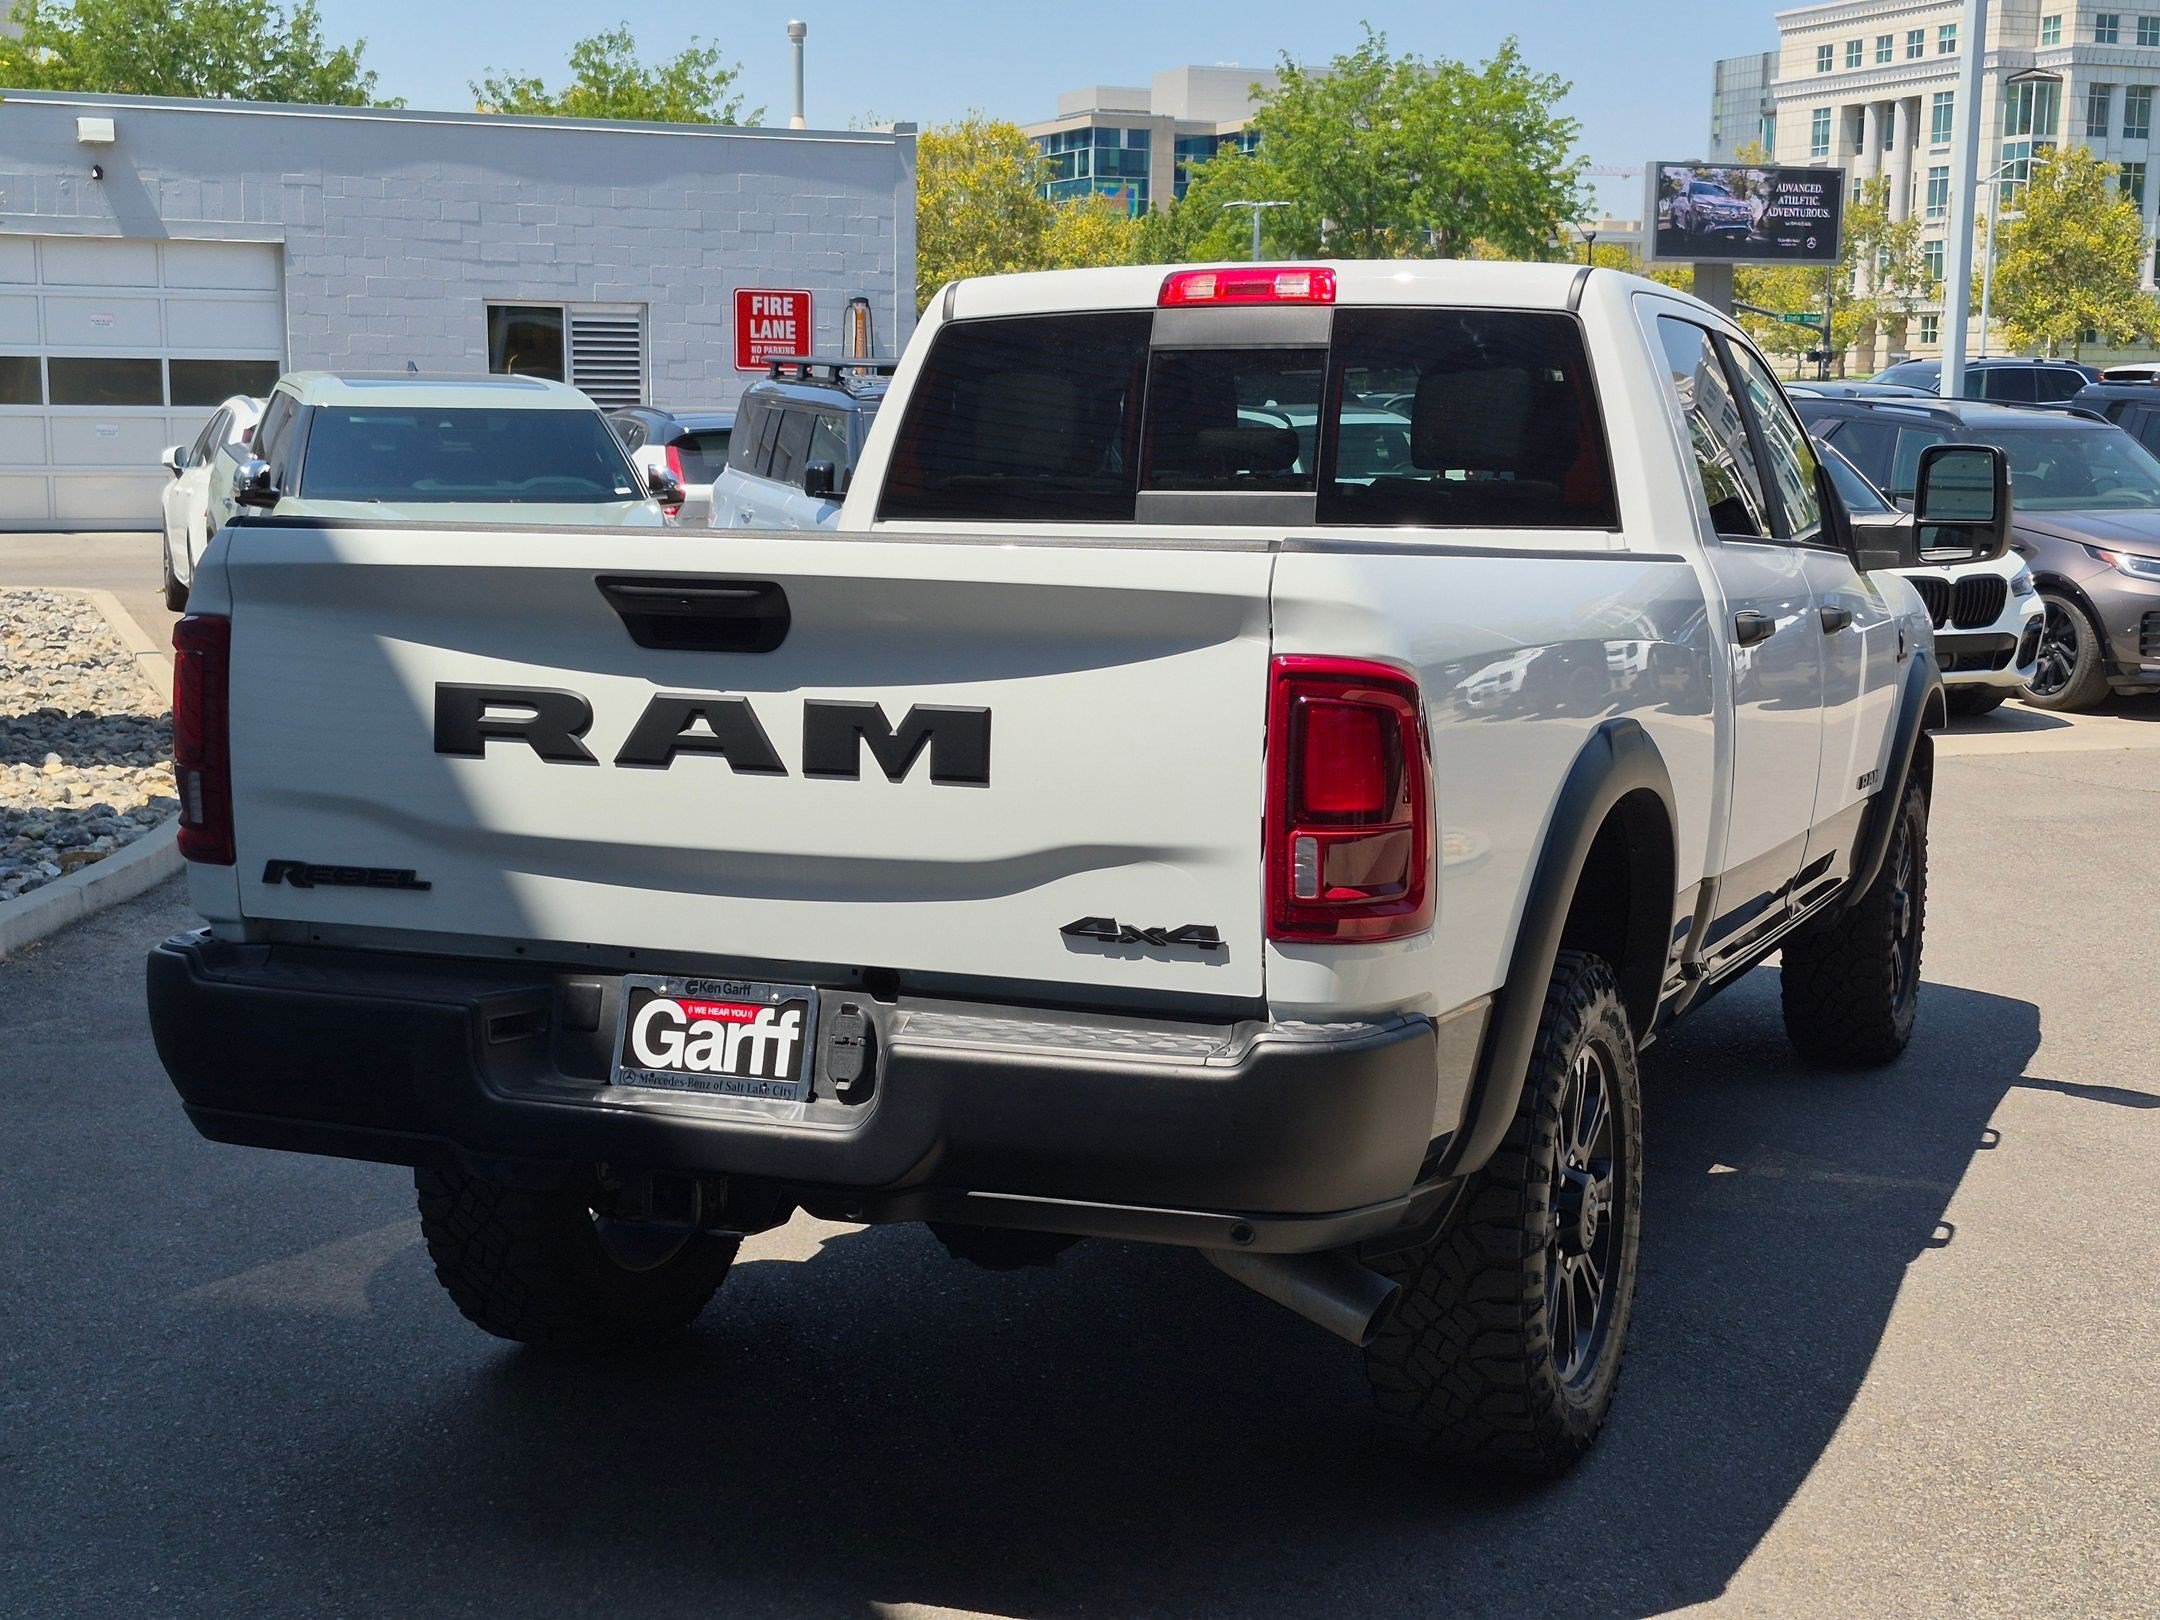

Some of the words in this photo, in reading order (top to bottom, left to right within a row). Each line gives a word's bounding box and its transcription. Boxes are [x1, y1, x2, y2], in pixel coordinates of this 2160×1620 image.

[1776, 183, 1824, 193] ADVANCED.
[1766, 207, 1830, 218] ADVENTUROUS.
[752, 296, 793, 316] FIRE
[750, 319, 796, 340] LANE
[751, 345, 762, 354] NO
[763, 346, 796, 355] PARKING
[751, 356, 760, 364] AT
[434, 681, 993, 789] RAM
[699, 980, 721, 993] Ken
[723, 982, 752, 996] Garff
[694, 1006, 707, 1015] WE
[708, 1007, 730, 1016] HEAR
[731, 1009, 748, 1018] YOU
[632, 999, 801, 1078] Garff
[638, 1072, 711, 1090] Mercedes-Benz
[713, 1081, 723, 1091] of
[725, 1081, 744, 1093] Salt
[747, 1083, 770, 1095] Lake
[772, 1085, 794, 1098] City
